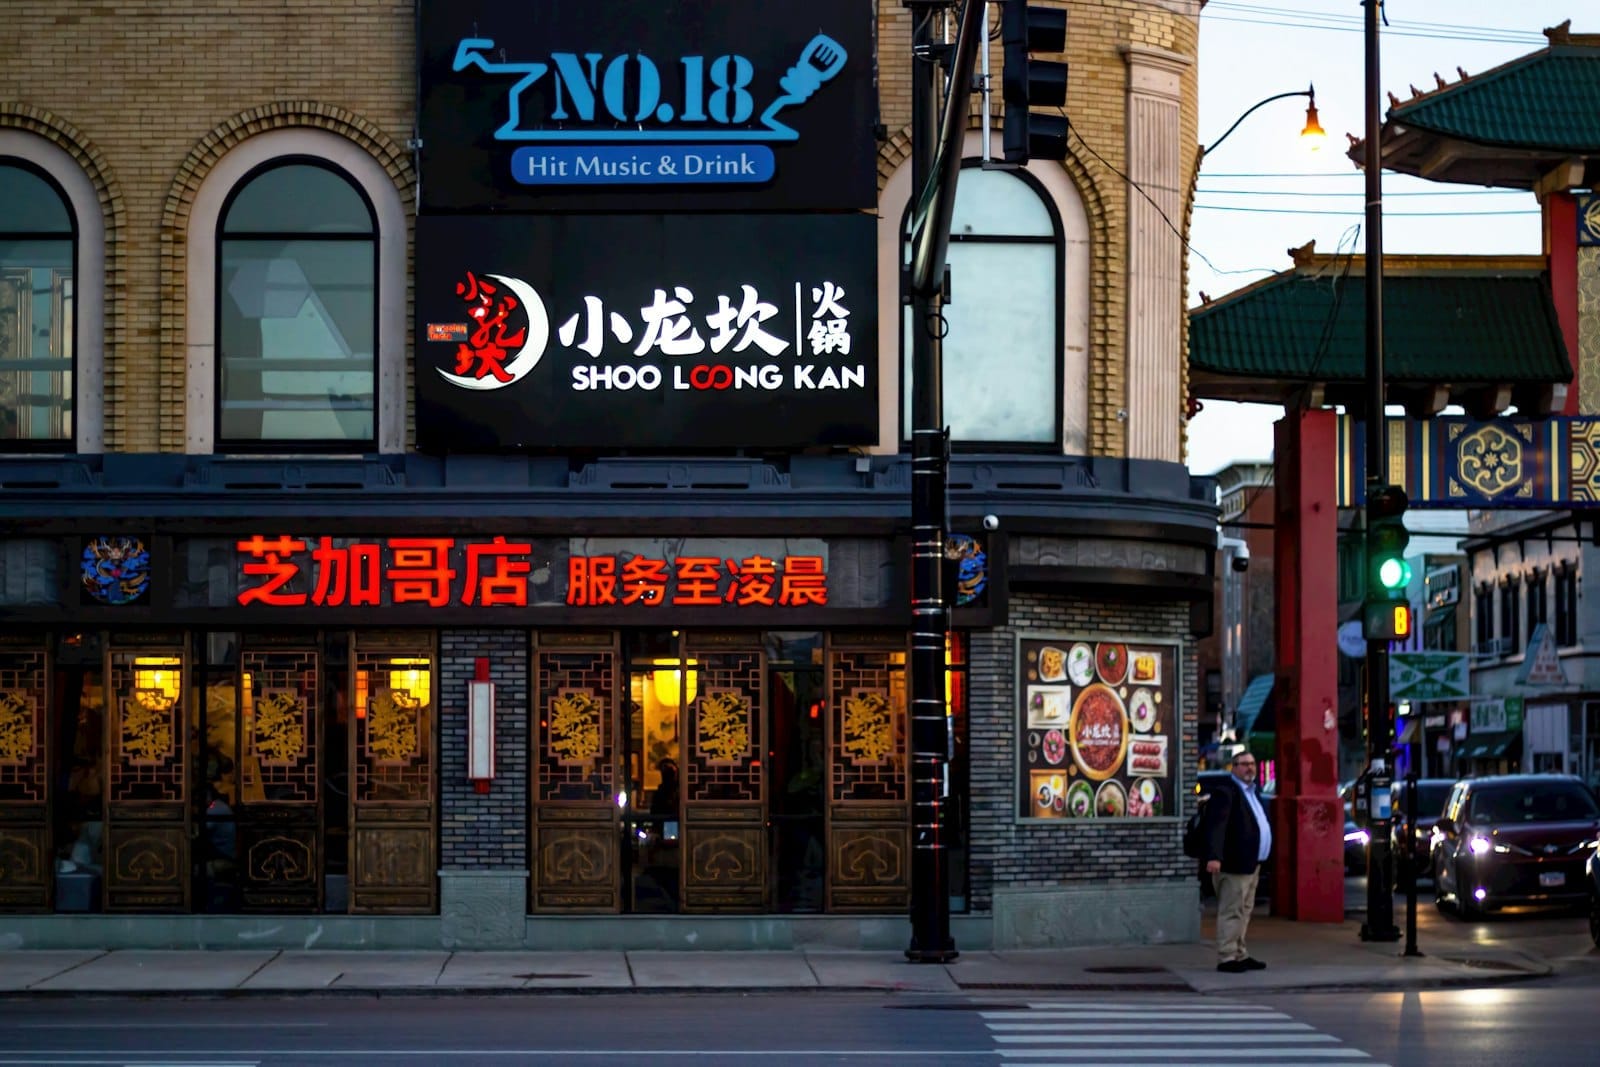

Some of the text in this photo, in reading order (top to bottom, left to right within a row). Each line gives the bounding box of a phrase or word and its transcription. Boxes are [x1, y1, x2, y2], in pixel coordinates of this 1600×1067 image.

[551, 53, 754, 124] NO.18
[528, 153, 755, 177] Hit Music & Drink
[558, 284, 790, 358] 小龙坎
[806, 280, 851, 356] 火锅
[571, 364, 865, 391] SHOO LOONG KAN
[237, 535, 532, 607] 芝加哥店
[566, 554, 827, 606] 服务至凌晨
